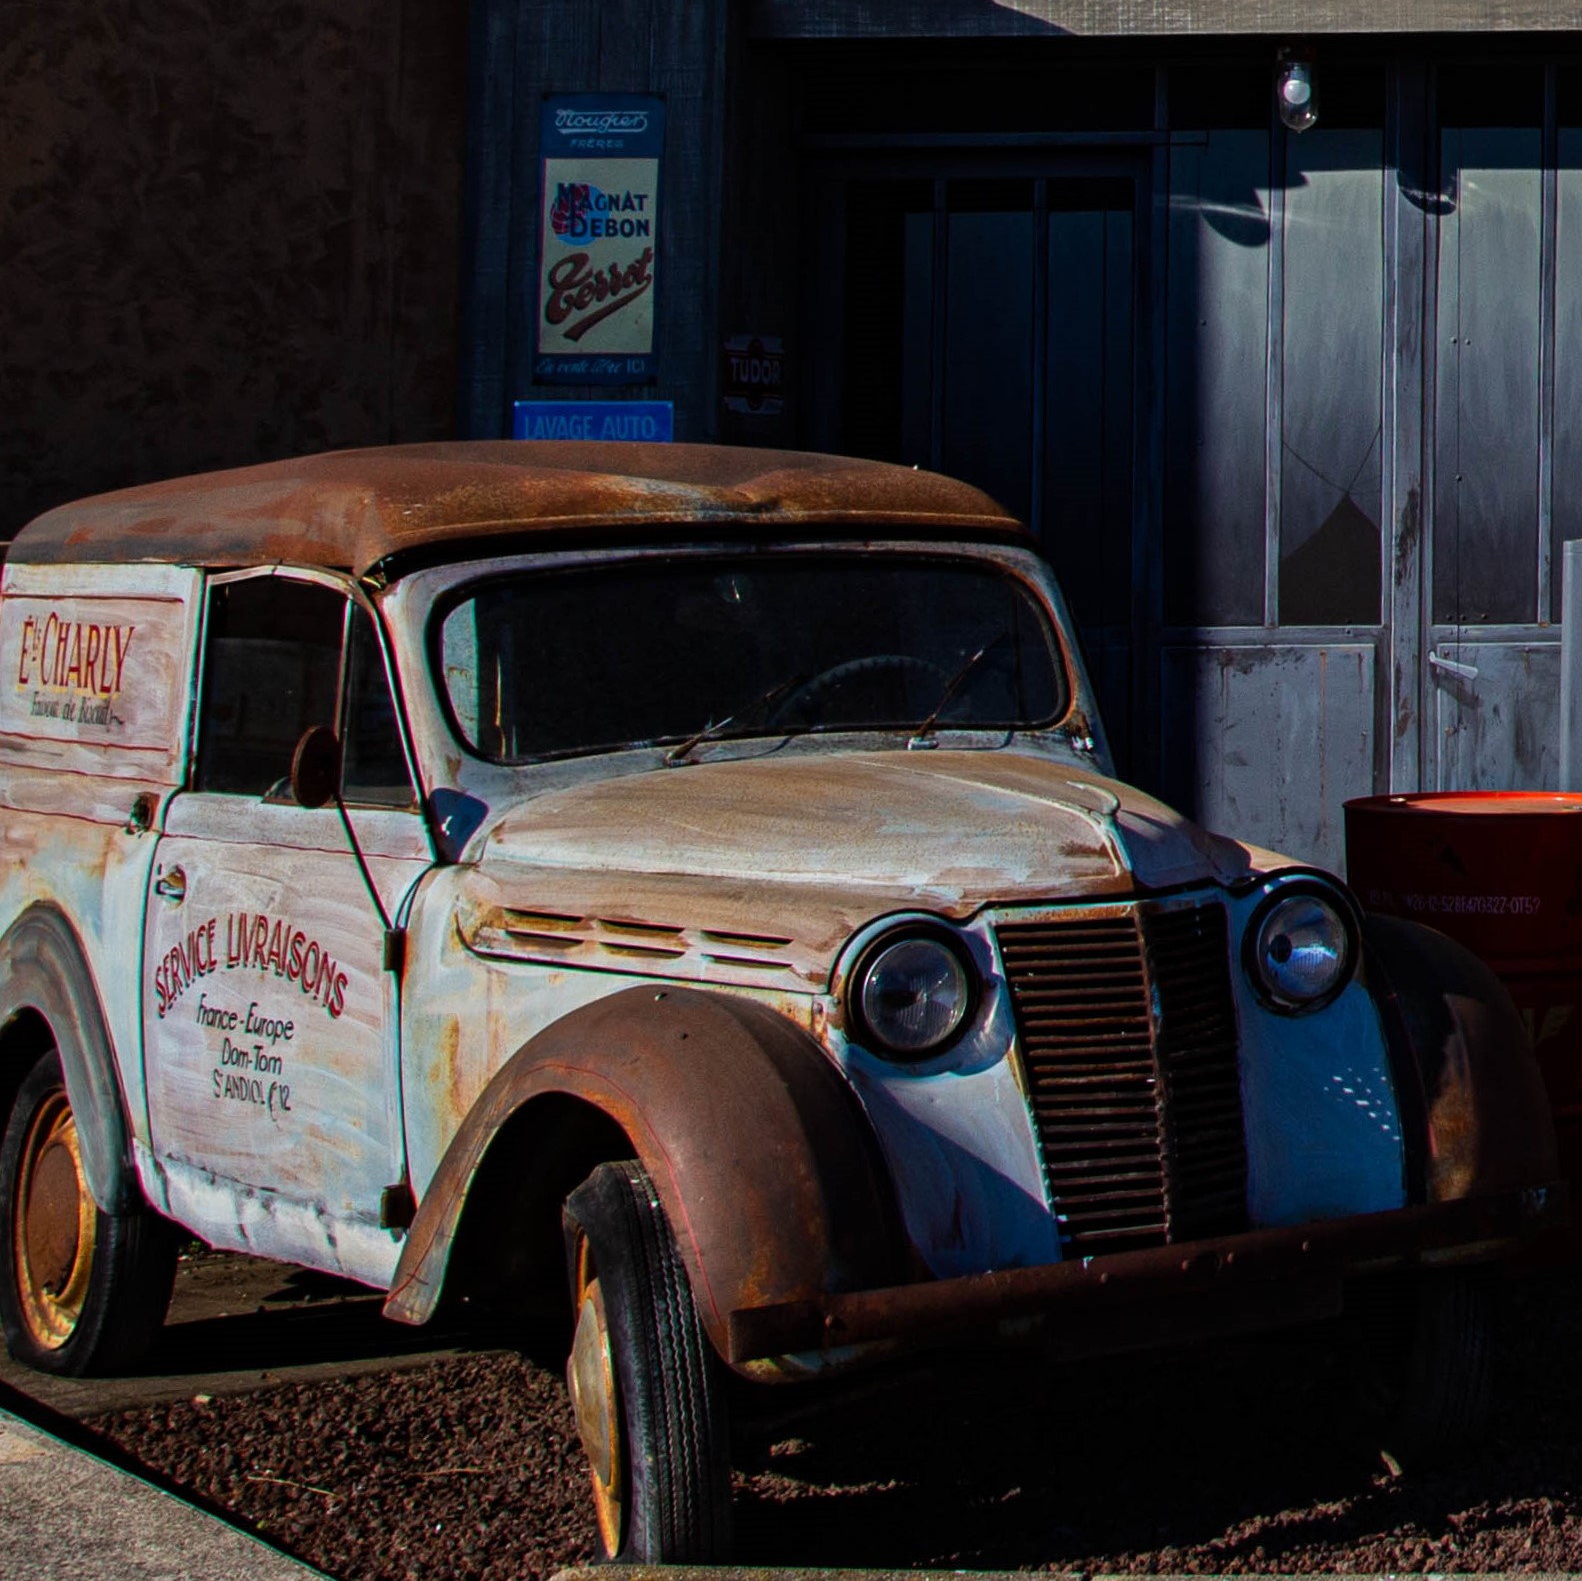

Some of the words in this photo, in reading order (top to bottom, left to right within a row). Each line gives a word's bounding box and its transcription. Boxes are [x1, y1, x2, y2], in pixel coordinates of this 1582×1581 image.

[556, 182, 648, 212] MAGNAT
[569, 215, 650, 237] DEBON
[729, 357, 782, 384] TUDOR
[524, 414, 593, 439] LAVAGE
[600, 414, 657, 439] AUTO
[40, 611, 136, 695] CHARLY
[155, 918, 218, 1018] SERVICE
[226, 912, 349, 1019] LIVRAISONS
